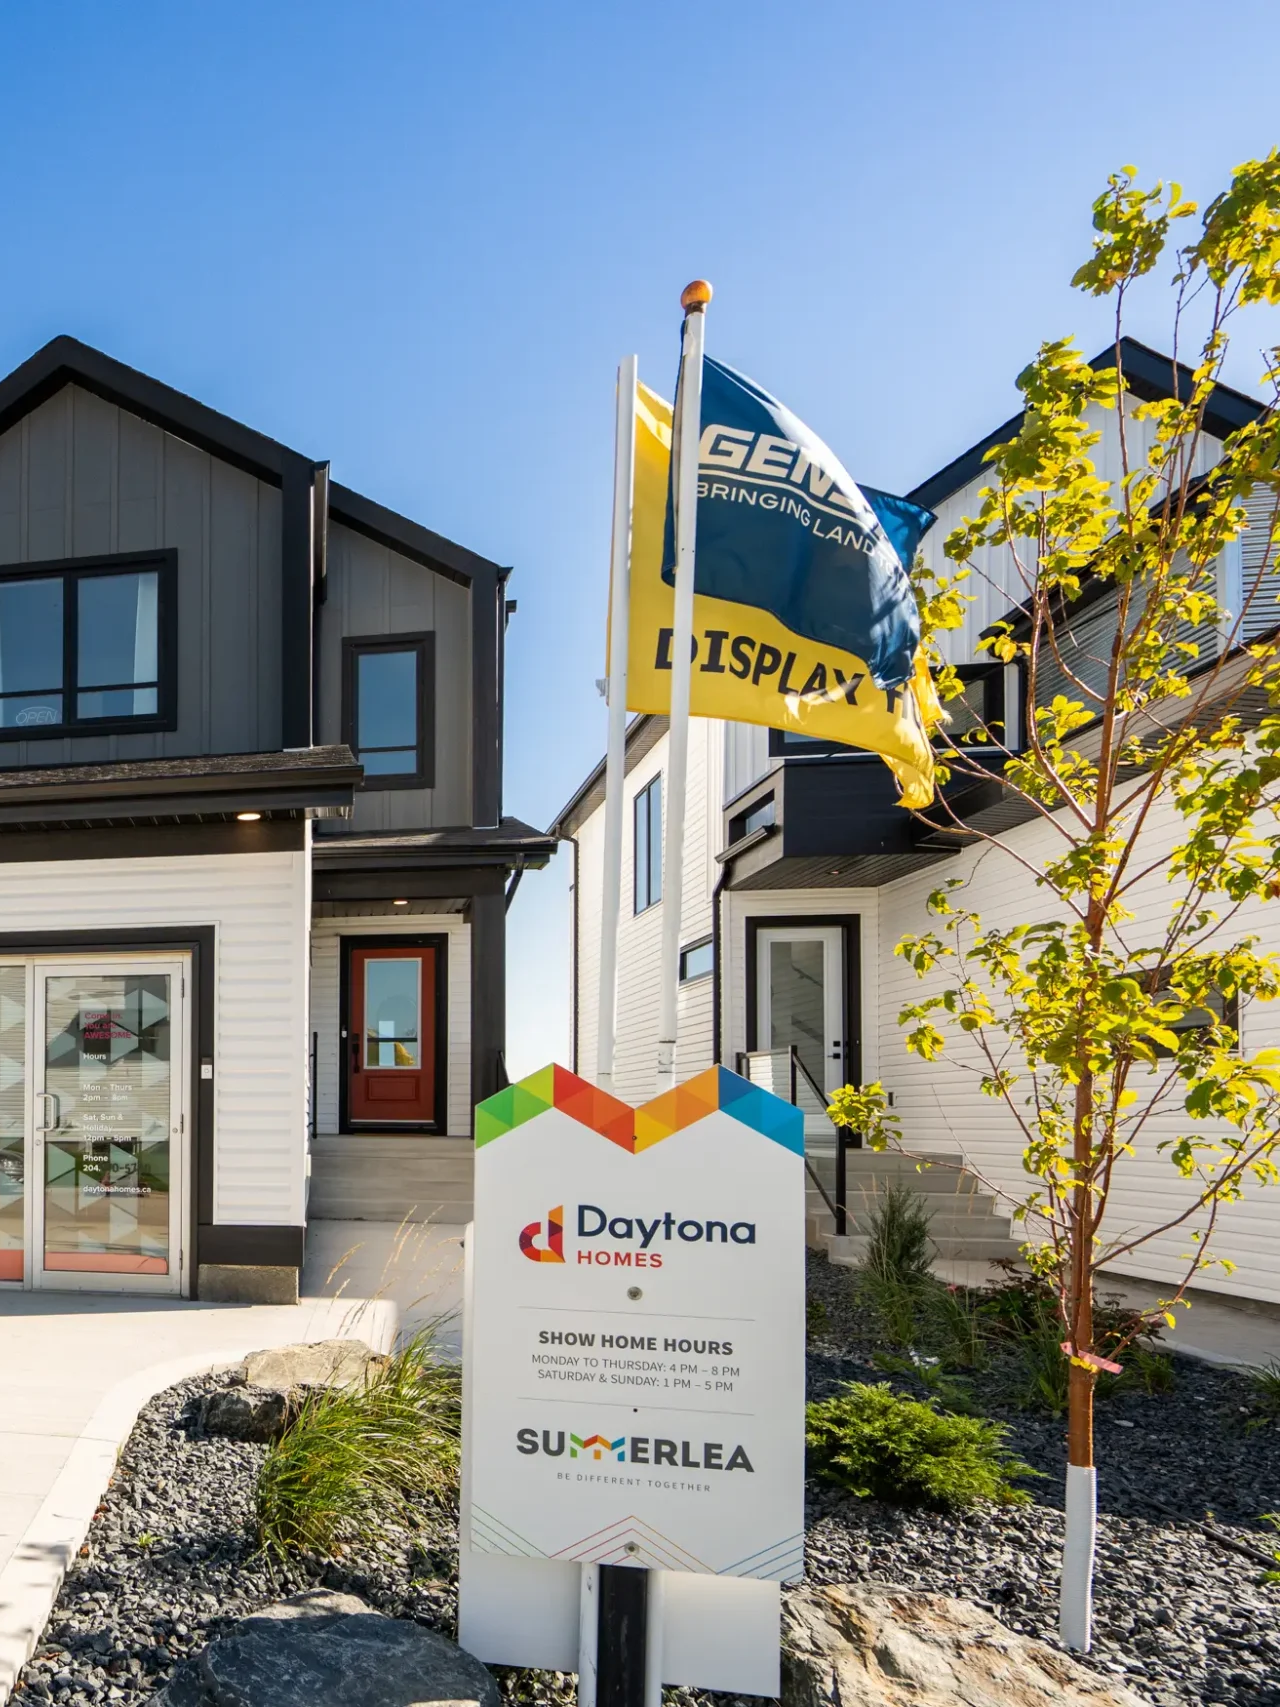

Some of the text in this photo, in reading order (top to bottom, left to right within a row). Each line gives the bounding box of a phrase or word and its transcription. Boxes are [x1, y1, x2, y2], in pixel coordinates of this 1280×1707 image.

[698, 424, 857, 511] GEN
[696, 482, 810, 527] BRINGING
[812, 518, 876, 557] LAND
[654, 628, 866, 706] DISPLAY
[16, 710, 57, 725] OPEN
[84, 1031, 132, 1039] AWESOME
[110, 1083, 133, 1091] Thurs
[83, 1094, 101, 1102] 2pm
[100, 1113, 116, 1121] Sun
[83, 1134, 105, 1143] 12pm
[82, 1154, 109, 1162] Phone
[83, 1185, 152, 1194] daytonahomes.ca
[577, 1204, 756, 1249] Daytona
[577, 1250, 663, 1268] HOMES
[538, 1330, 734, 1356] SHOW HOME HOURS
[531, 1354, 580, 1366] MONDAY
[583, 1357, 599, 1368] TO
[602, 1358, 667, 1373] THURSDAY:
[669, 1363, 676, 1373] 4
[680, 1364, 698, 1375] PM
[711, 1365, 719, 1376] 8
[722, 1366, 740, 1377] PM
[538, 1369, 596, 1382] SATURDAY
[599, 1373, 608, 1383] &
[610, 1374, 660, 1387] SUNDAY:
[663, 1377, 670, 1388] 1
[673, 1378, 691, 1389] PM
[704, 1379, 712, 1391] 5
[715, 1381, 733, 1392] PM
[516, 1428, 755, 1473] SUMMERLEA
[557, 1472, 712, 1493] BE DIFFERENT TOGETHER
